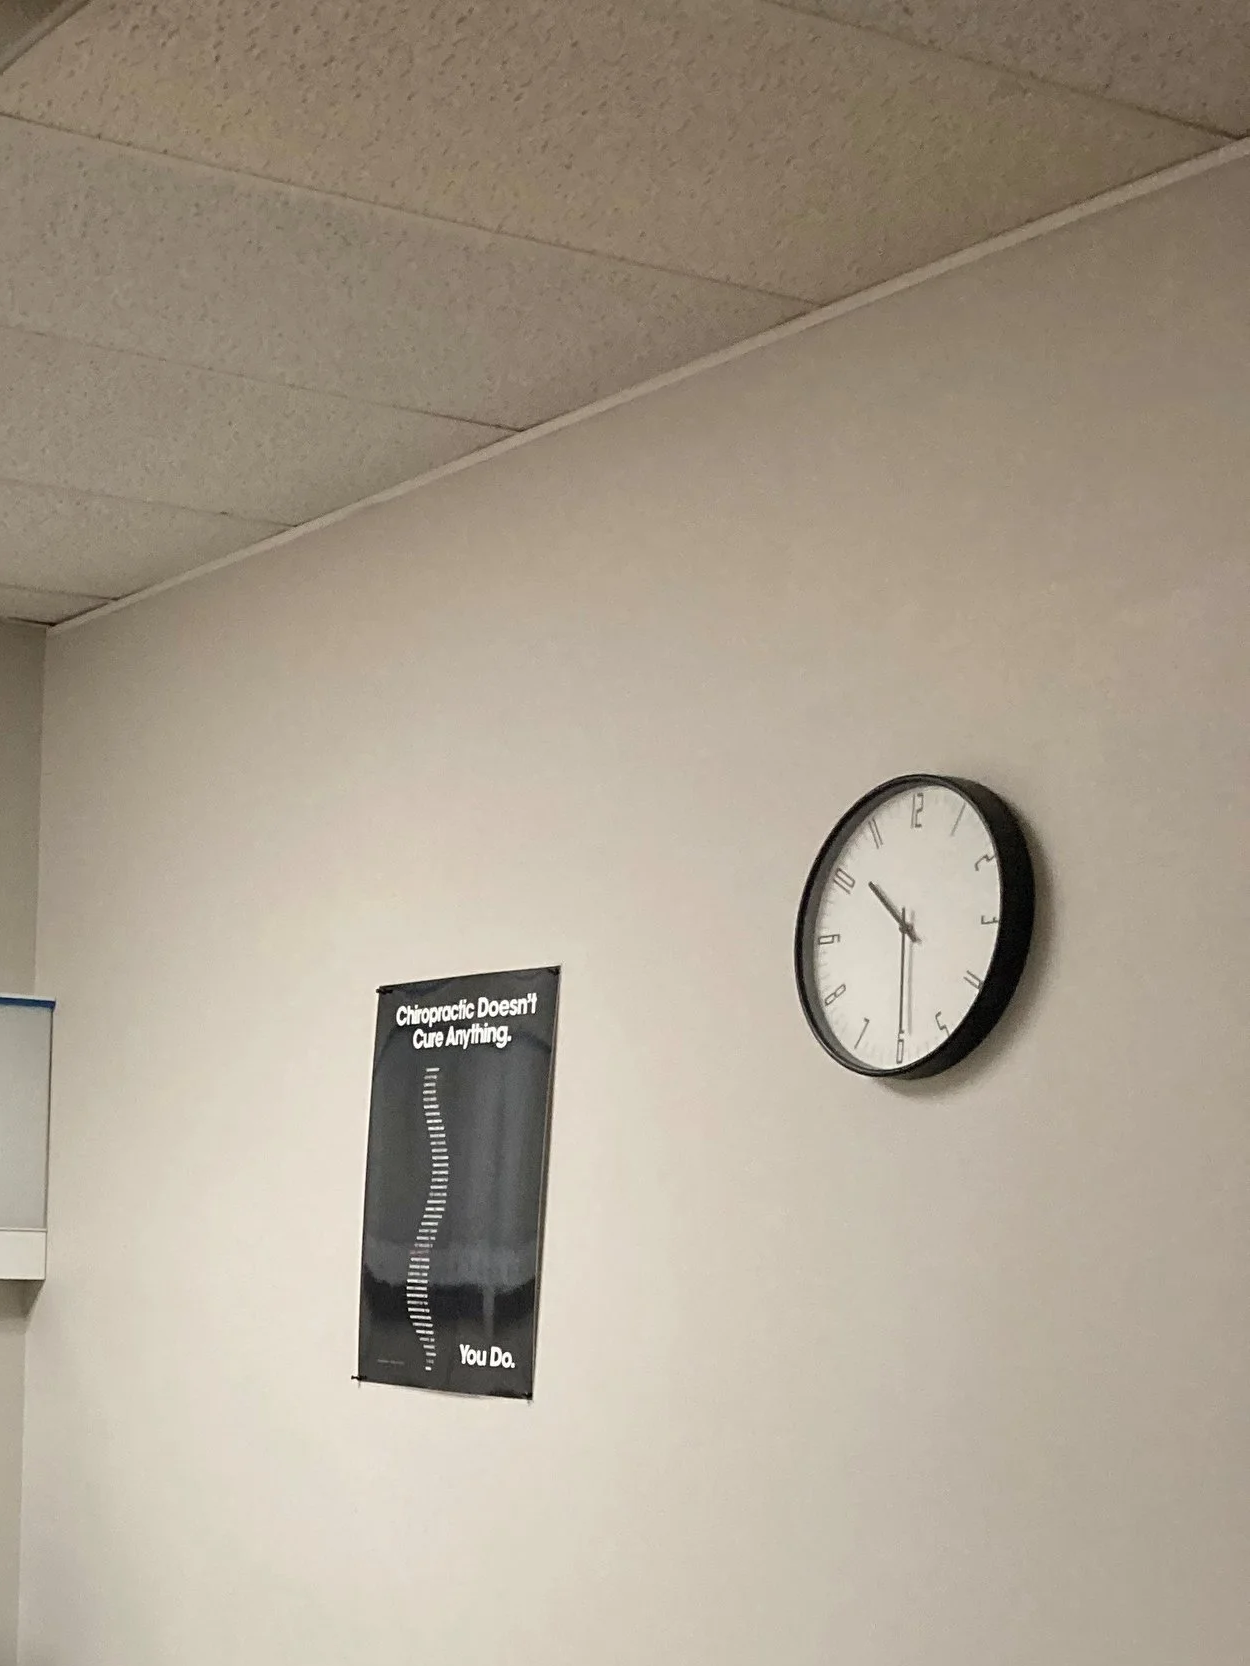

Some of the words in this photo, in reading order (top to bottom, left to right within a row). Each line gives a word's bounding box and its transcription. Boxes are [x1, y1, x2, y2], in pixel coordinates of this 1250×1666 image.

[910, 792, 924, 829] 12
[950, 801, 967, 837] 1
[867, 817, 883, 850] 11
[832, 867, 856, 895] 10
[817, 934, 841, 945] 9
[395, 999, 475, 1027] Chiropractic
[477, 992, 538, 1018] Doesn't
[824, 983, 847, 1006] 8
[412, 1028, 444, 1050] Cure
[445, 1022, 512, 1050] Anything.
[853, 1018, 870, 1050] 7
[459, 1343, 487, 1366] You
[489, 1345, 516, 1369] Do.
